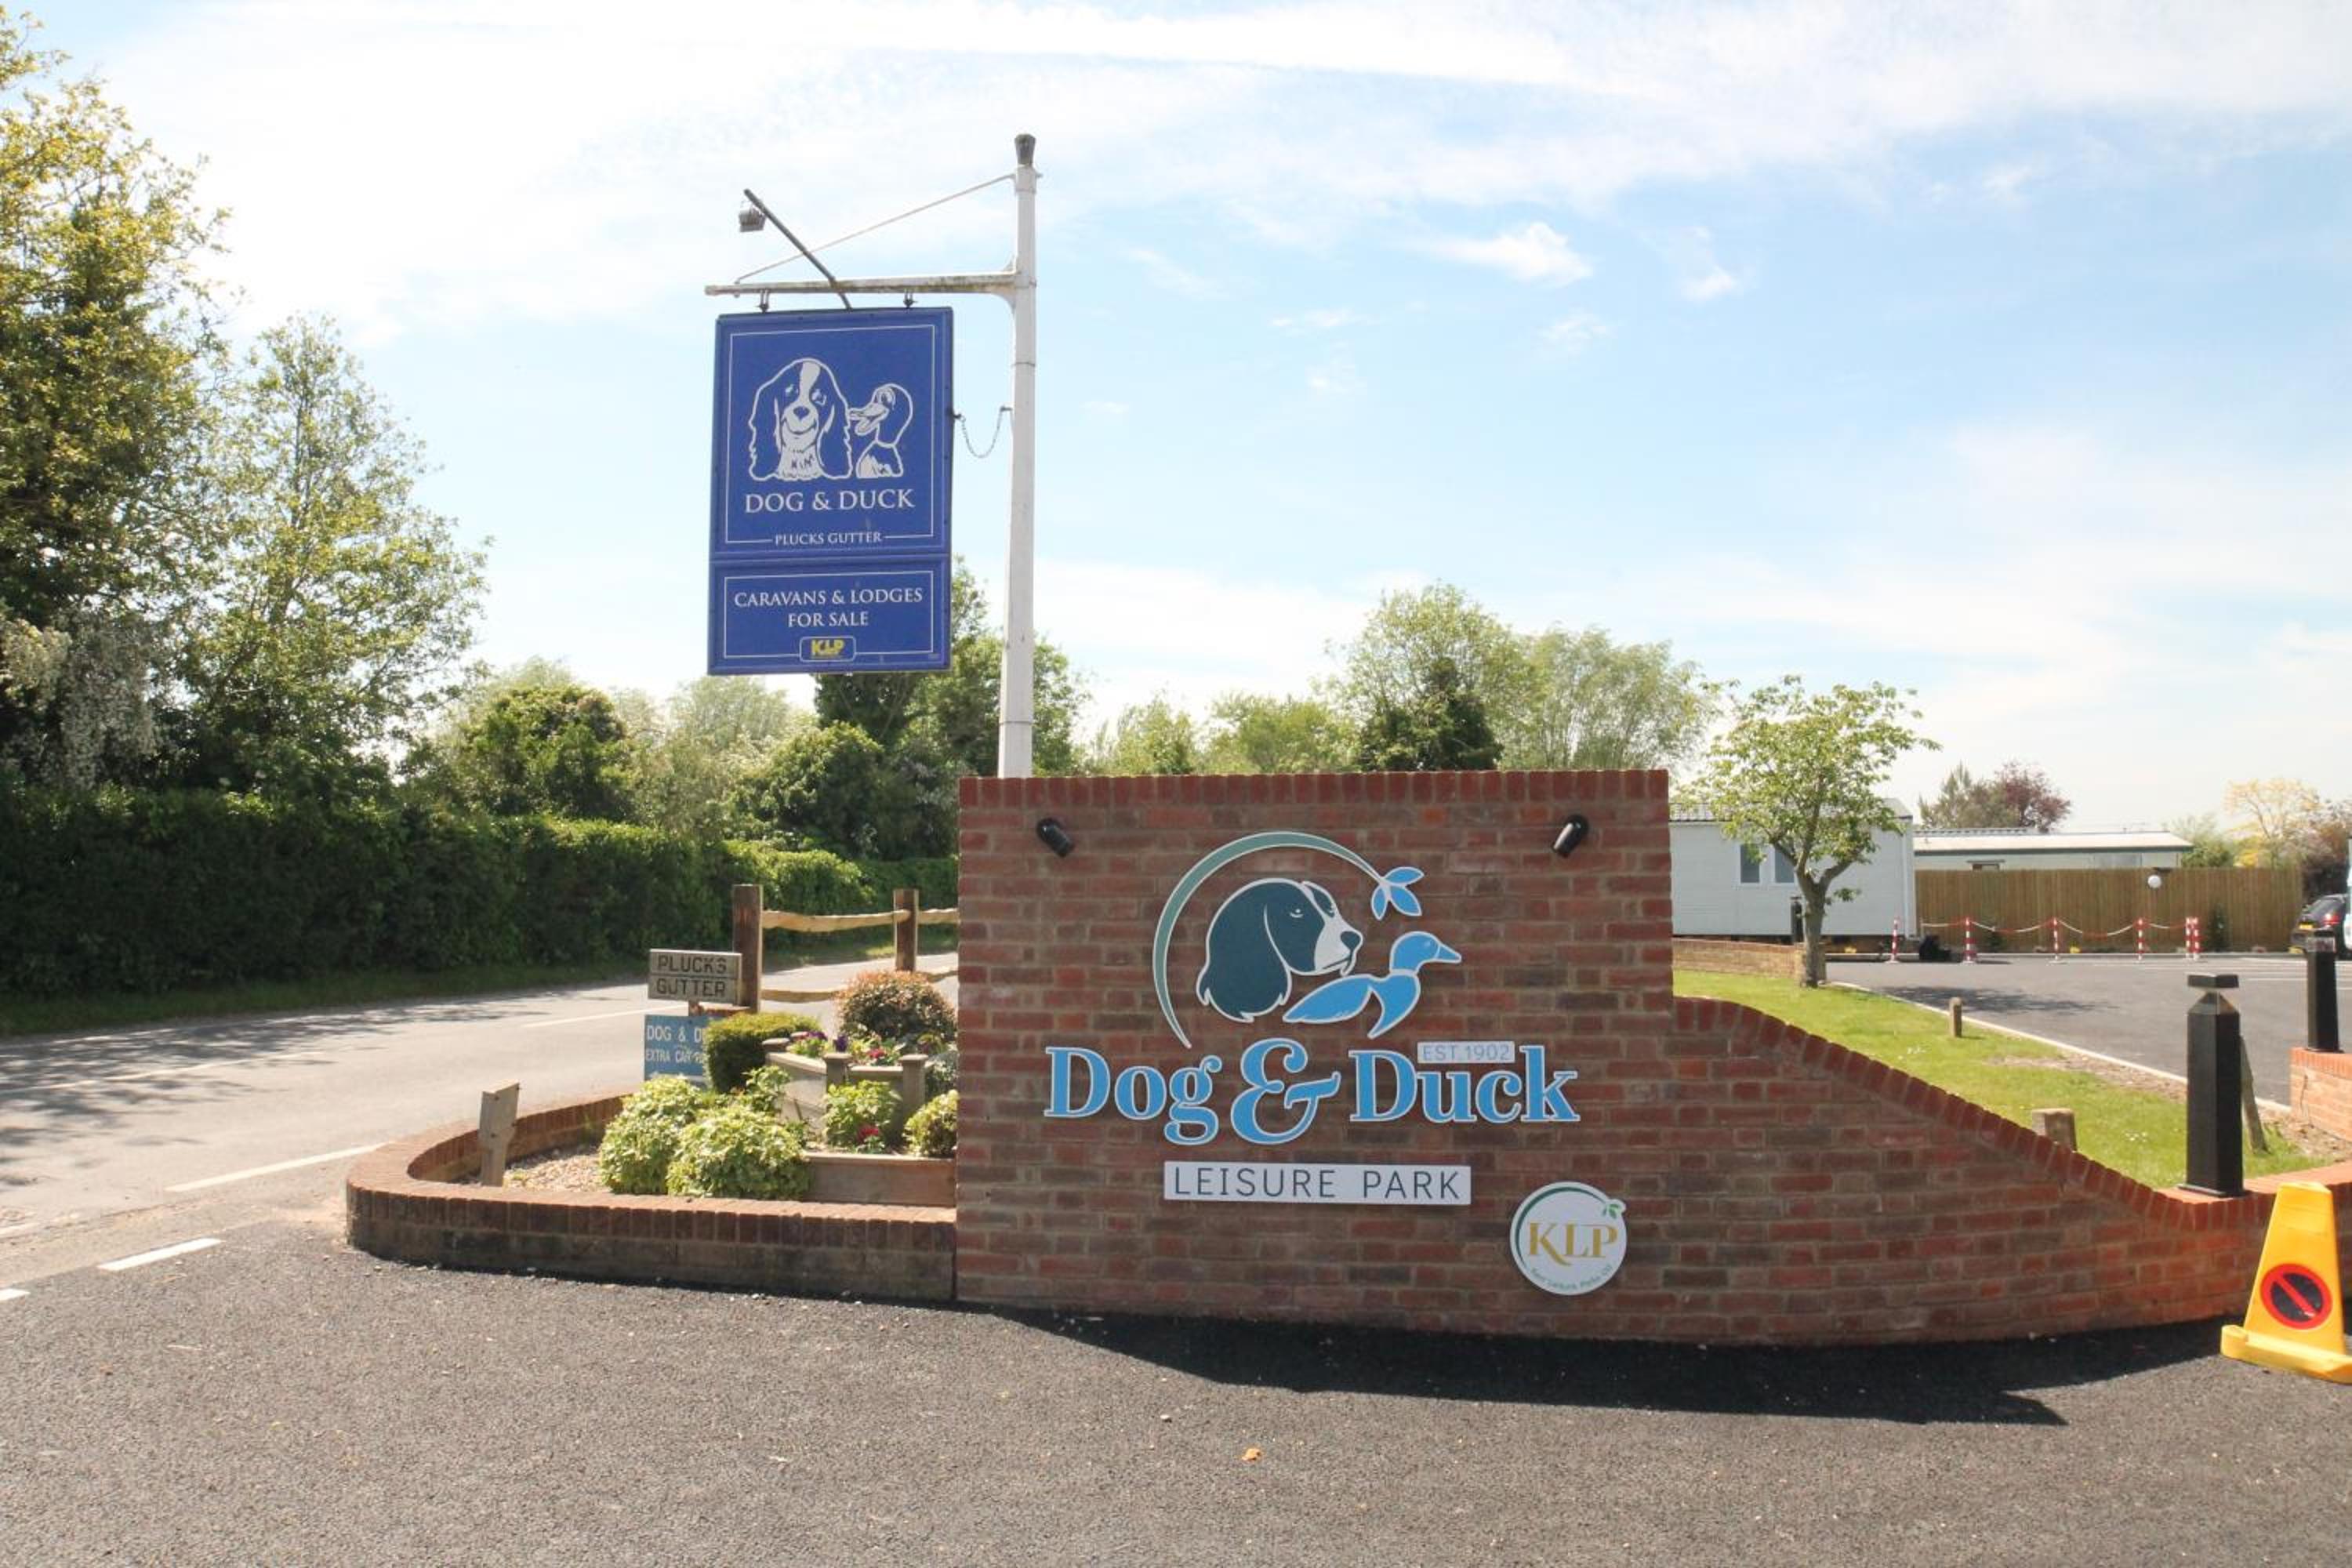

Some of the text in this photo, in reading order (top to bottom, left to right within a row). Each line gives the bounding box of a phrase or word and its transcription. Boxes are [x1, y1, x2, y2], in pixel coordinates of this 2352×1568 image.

[746, 488, 916, 514] DOG & DUCK
[775, 532, 882, 546] PLUCKS GUTTER
[734, 587, 923, 608] CARAVANS & LODGES
[788, 611, 869, 628] FOR SALE
[811, 639, 845, 655] KLP
[658, 954, 727, 974] PLUCKS
[656, 978, 725, 997] GUTTER
[647, 1025, 672, 1042] DOG
[678, 1025, 687, 1042] &
[1044, 1037, 1581, 1145] Dog & Duck
[1175, 1166, 1461, 1200] LEISURE PARK
[1528, 1221, 1618, 1266] KLP
